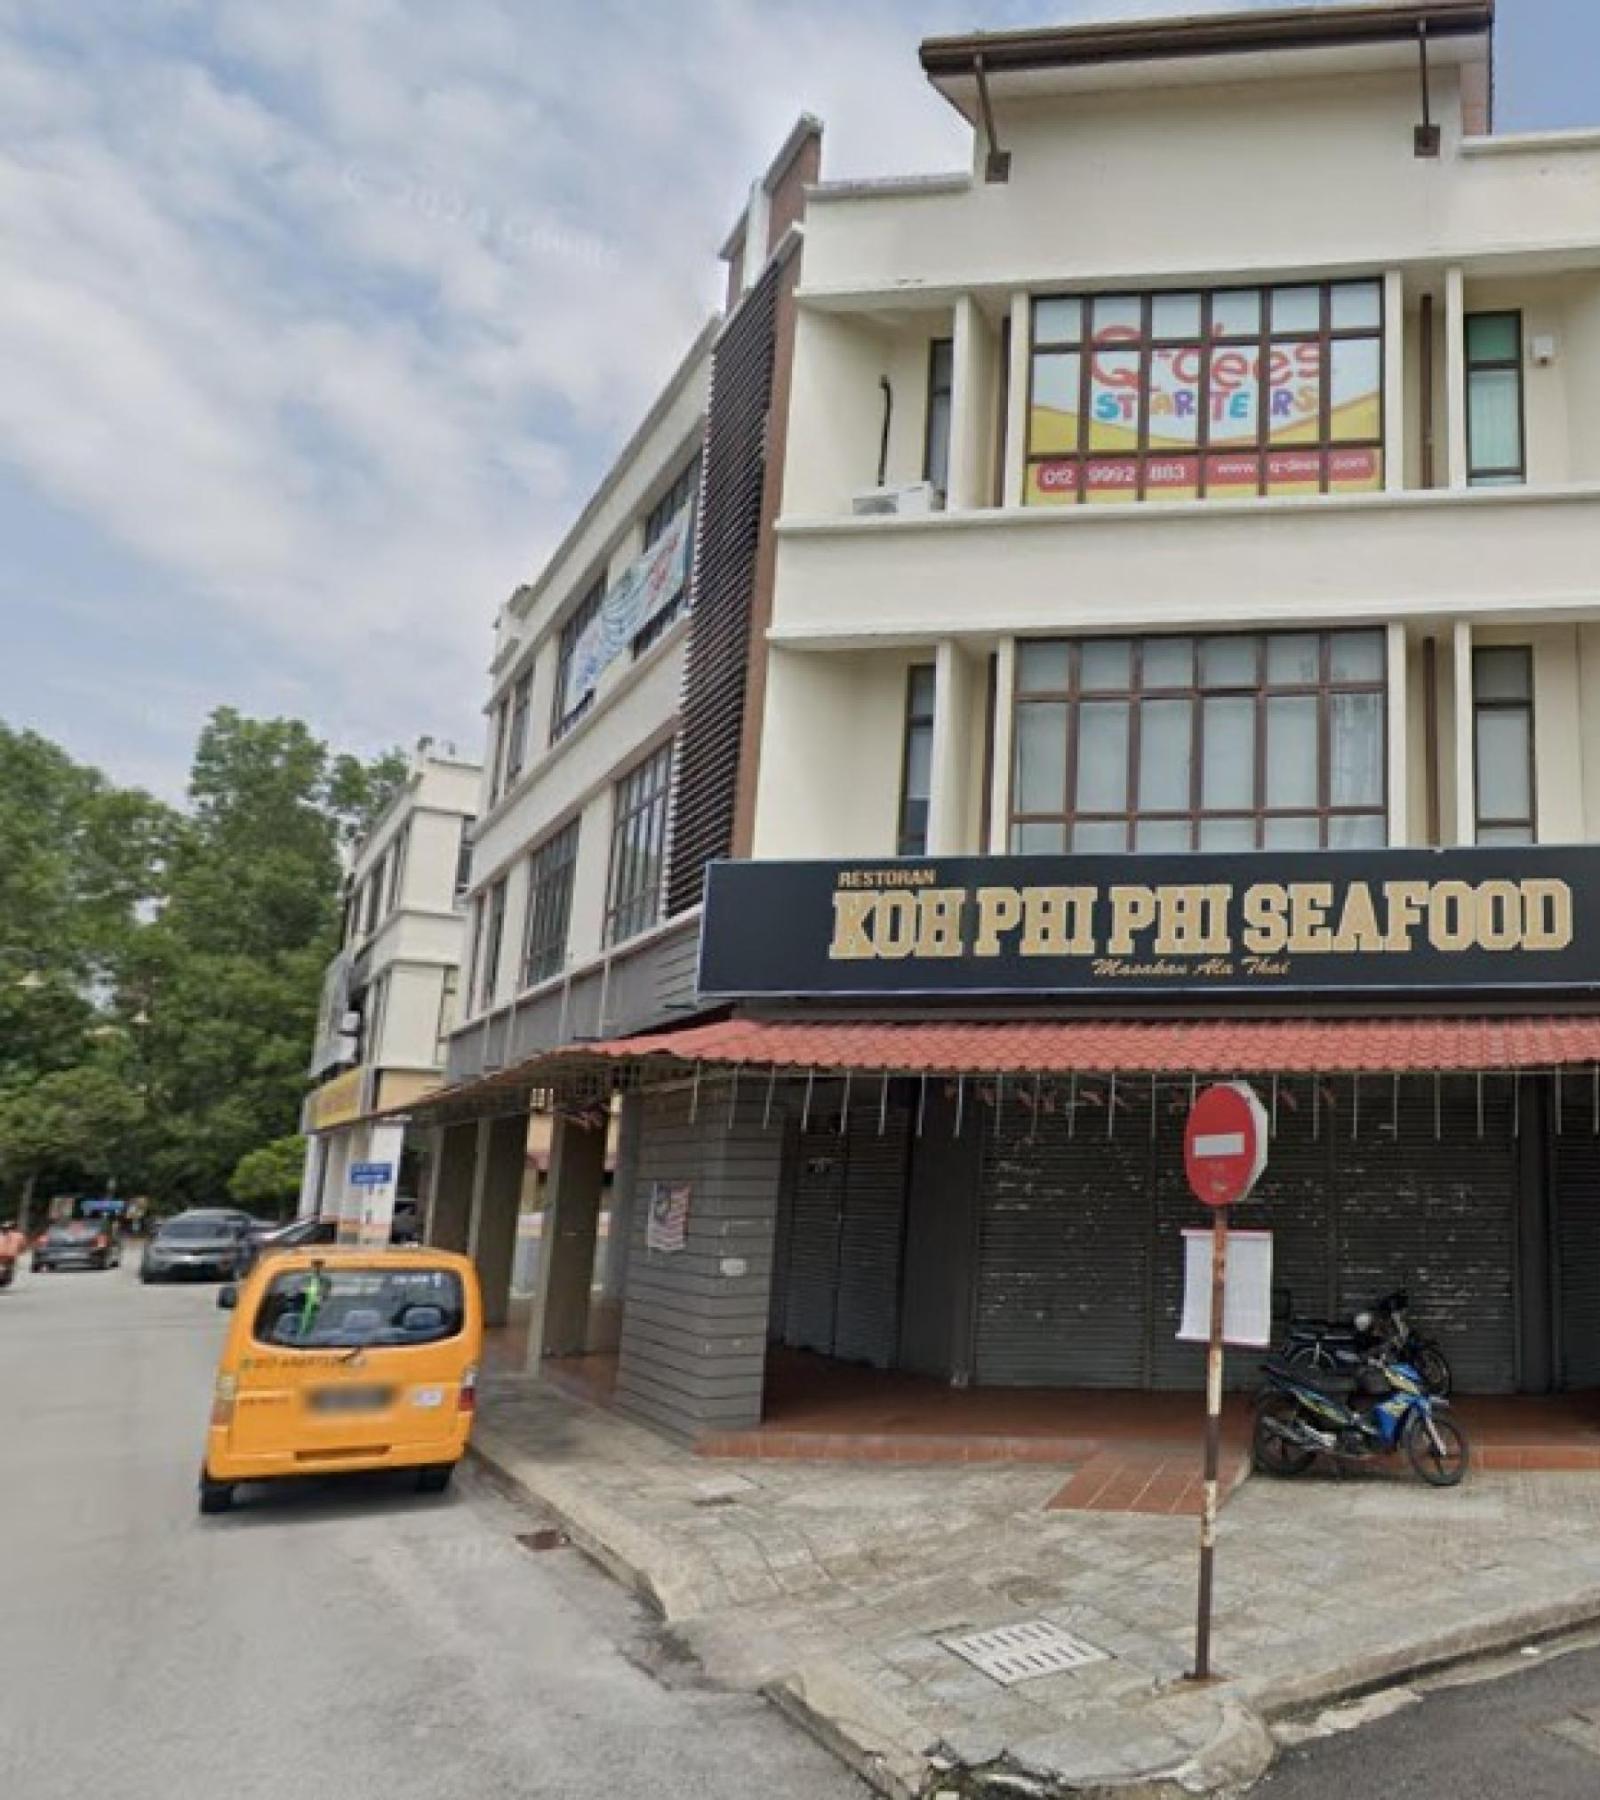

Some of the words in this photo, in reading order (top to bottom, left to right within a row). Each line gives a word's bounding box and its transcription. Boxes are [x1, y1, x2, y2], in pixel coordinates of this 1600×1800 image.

[1096, 386, 1319, 421] STARTERS
[838, 868, 936, 887] RESTORAN
[829, 888, 966, 959] KOH
[974, 885, 1098, 956] PHI
[1107, 883, 1234, 955] PHI
[1243, 877, 1573, 954] SEAFOOD
[1091, 957, 1187, 977] Masakan
[1192, 957, 1234, 977] Ala
[1241, 955, 1291, 976] Thai
